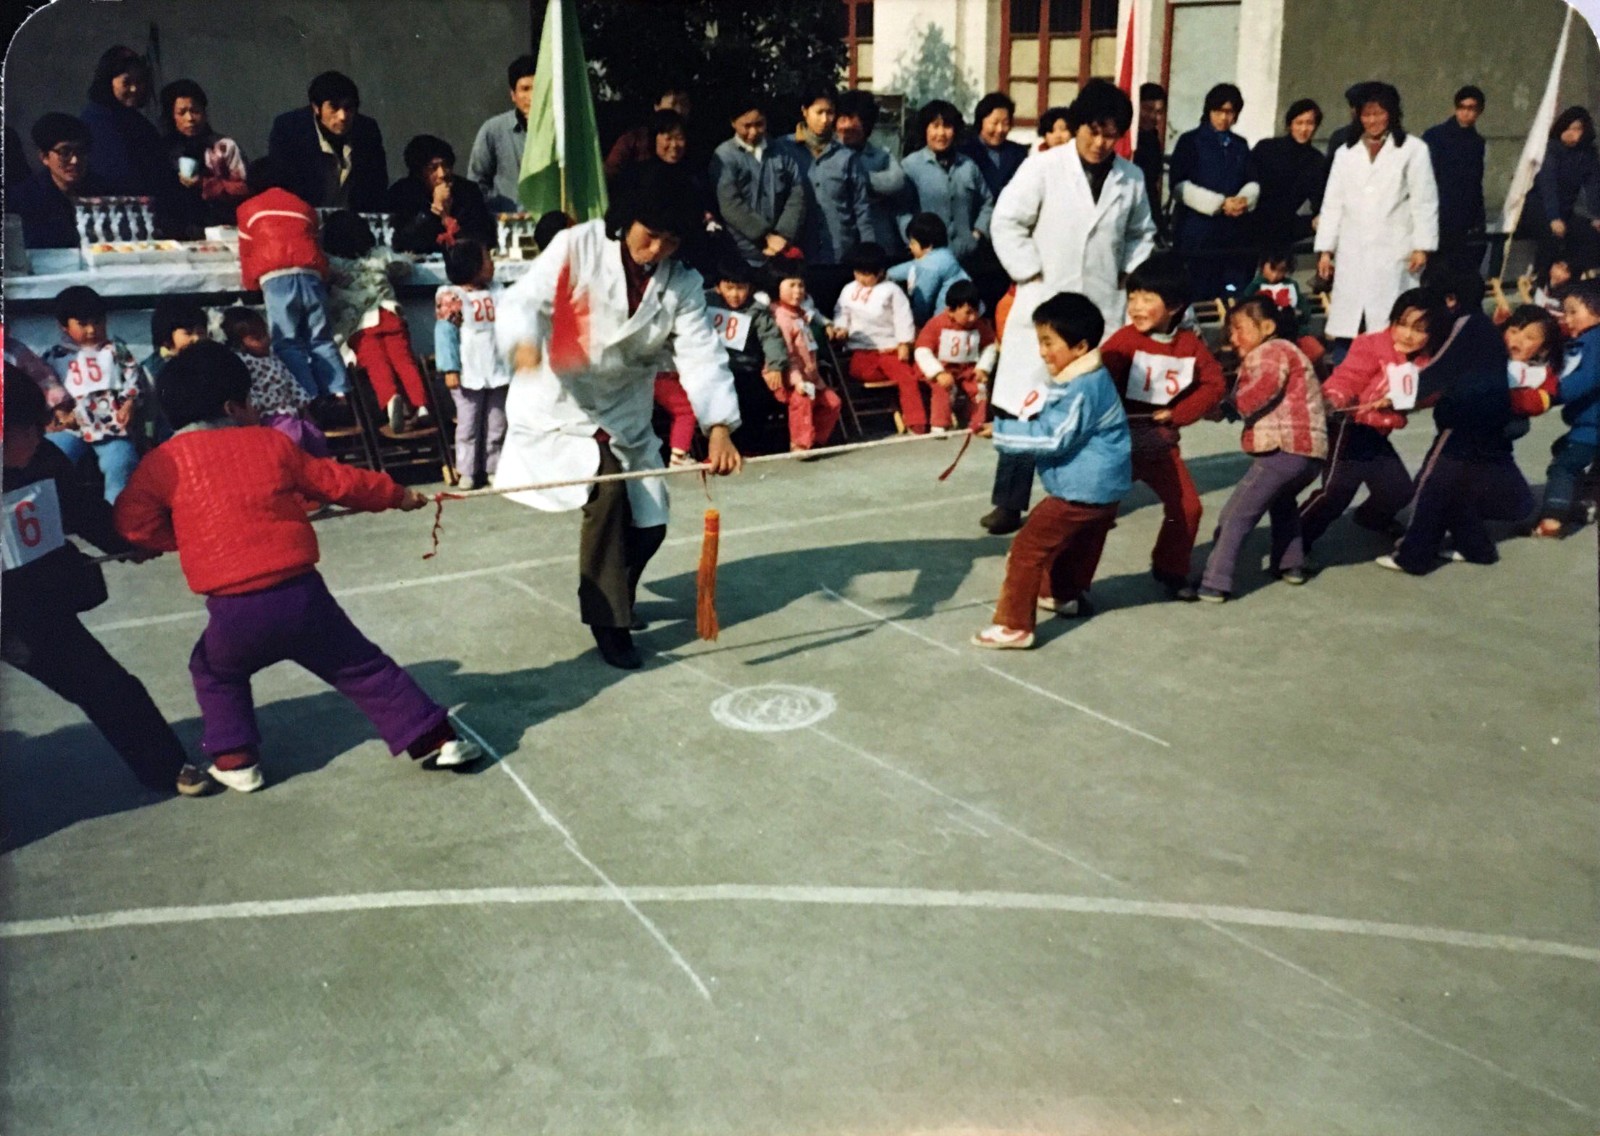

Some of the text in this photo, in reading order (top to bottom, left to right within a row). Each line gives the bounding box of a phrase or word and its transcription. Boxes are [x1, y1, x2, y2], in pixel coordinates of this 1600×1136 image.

[68, 357, 103, 385] 35
[1143, 366, 1180, 396] 15
[1402, 374, 1413, 396] 0
[15, 500, 42, 548] 6
